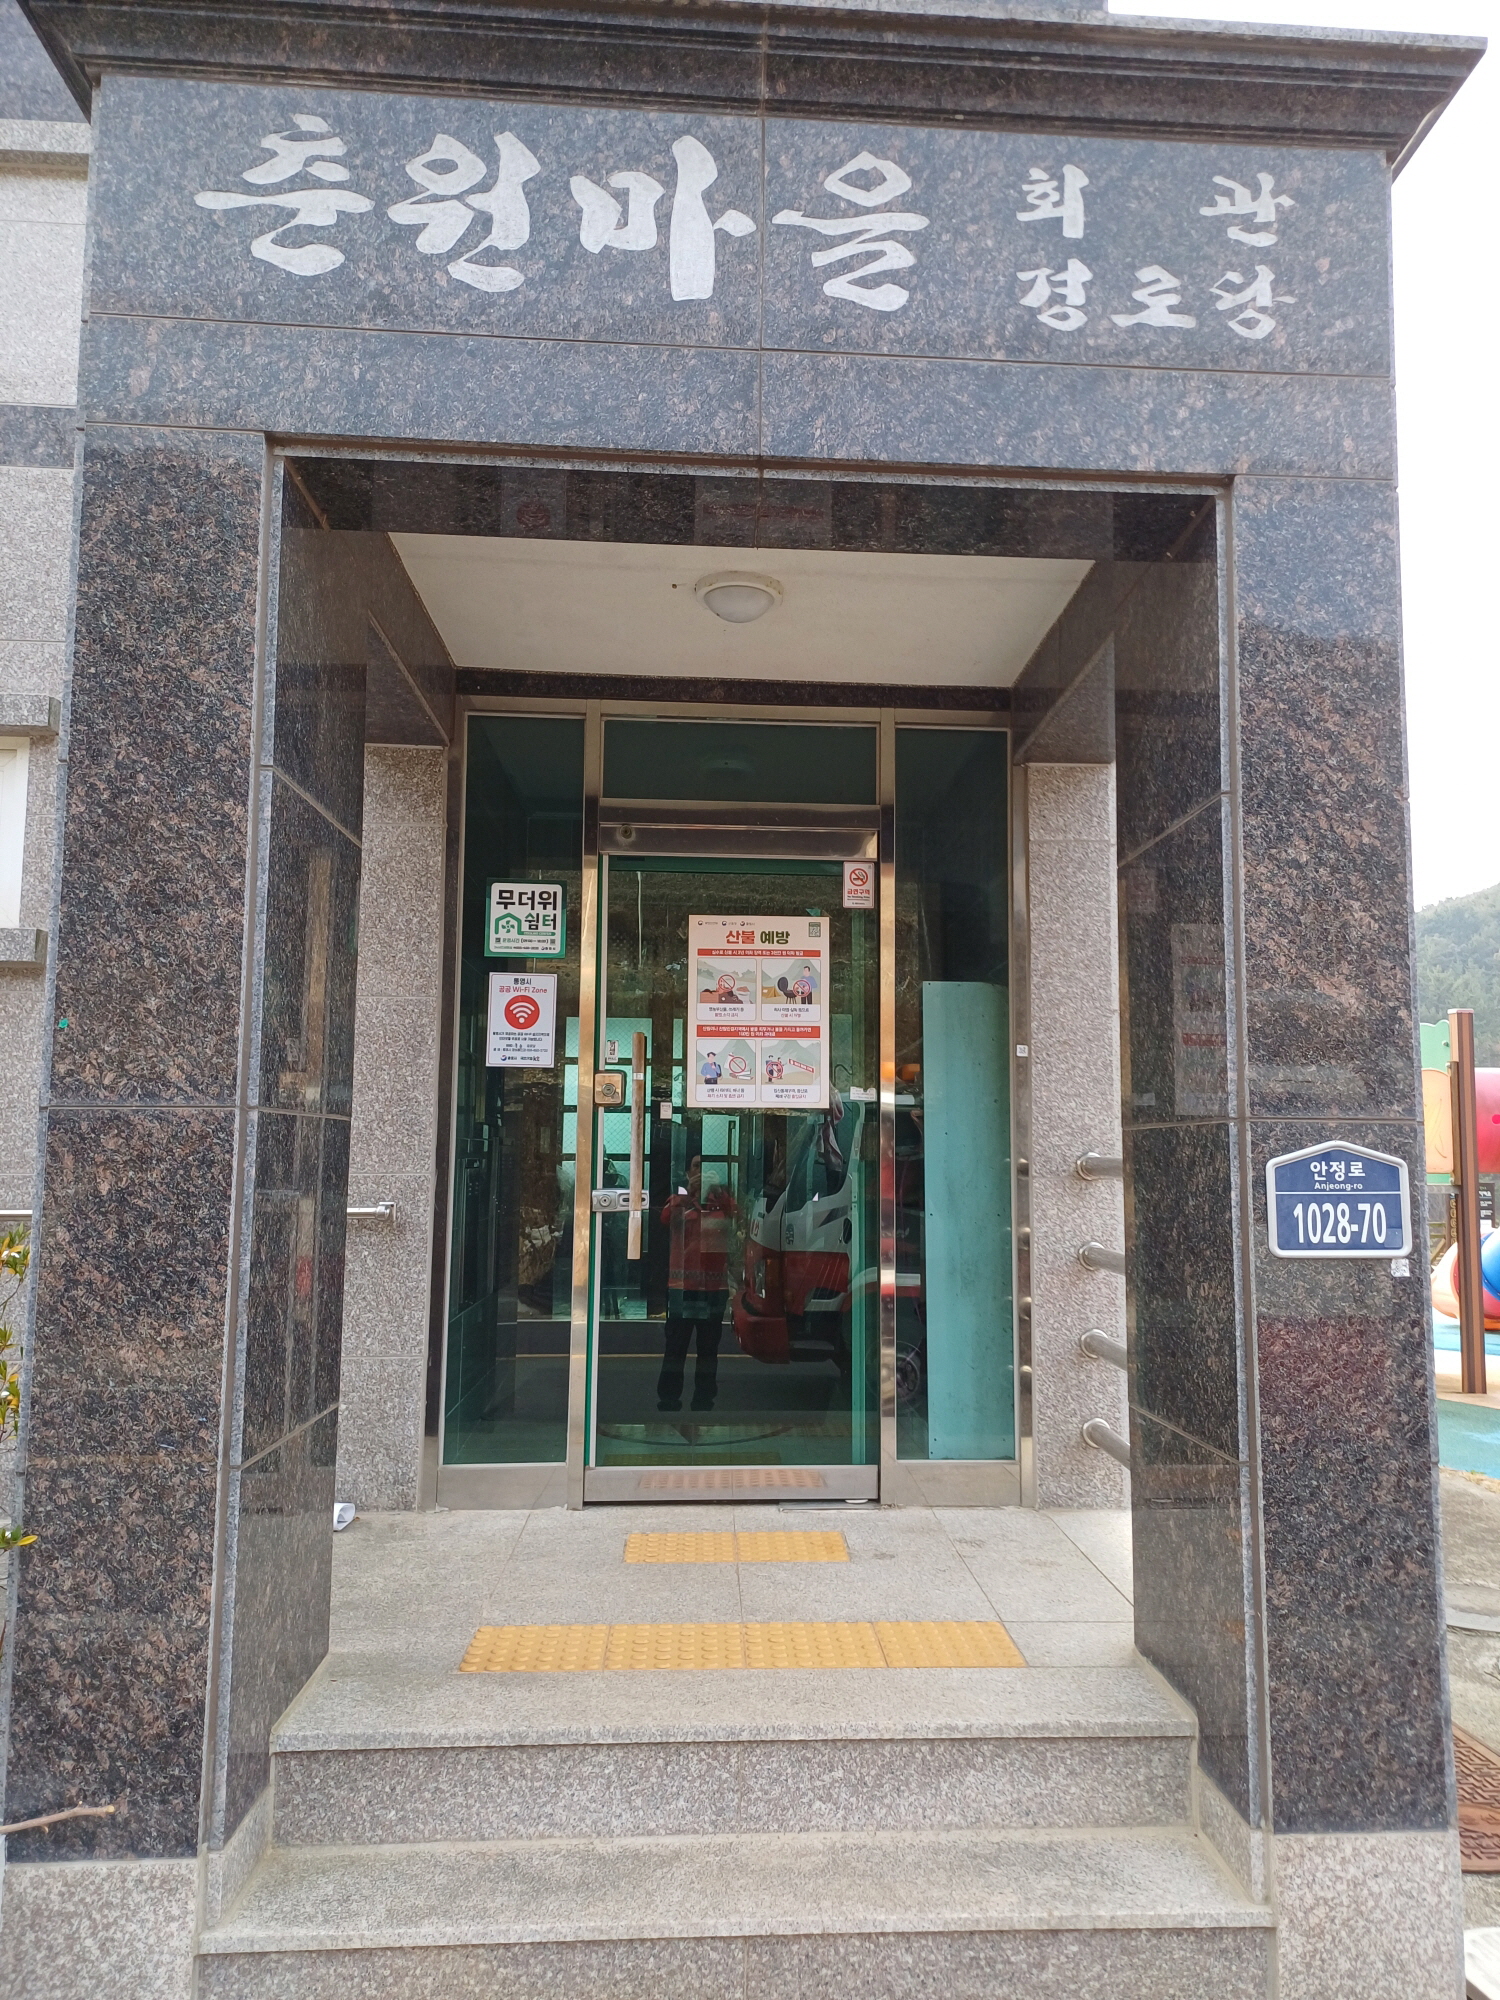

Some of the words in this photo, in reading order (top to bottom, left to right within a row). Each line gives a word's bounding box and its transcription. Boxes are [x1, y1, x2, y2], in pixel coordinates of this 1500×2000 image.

[194, 112, 932, 312] 춘원마을
[1016, 258, 1298, 340] 경로당
[496, 889, 558, 911] 무더위
[524, 912, 557, 931] 쉼터
[725, 930, 756, 945] 산불
[760, 930, 790, 945] 예방
[513, 977, 532, 985] 통영시
[1310, 1161, 1366, 1181] 안정로
[1314, 1182, 1363, 1191] Anjeong-ro
[1293, 1202, 1387, 1244] 1028-70
